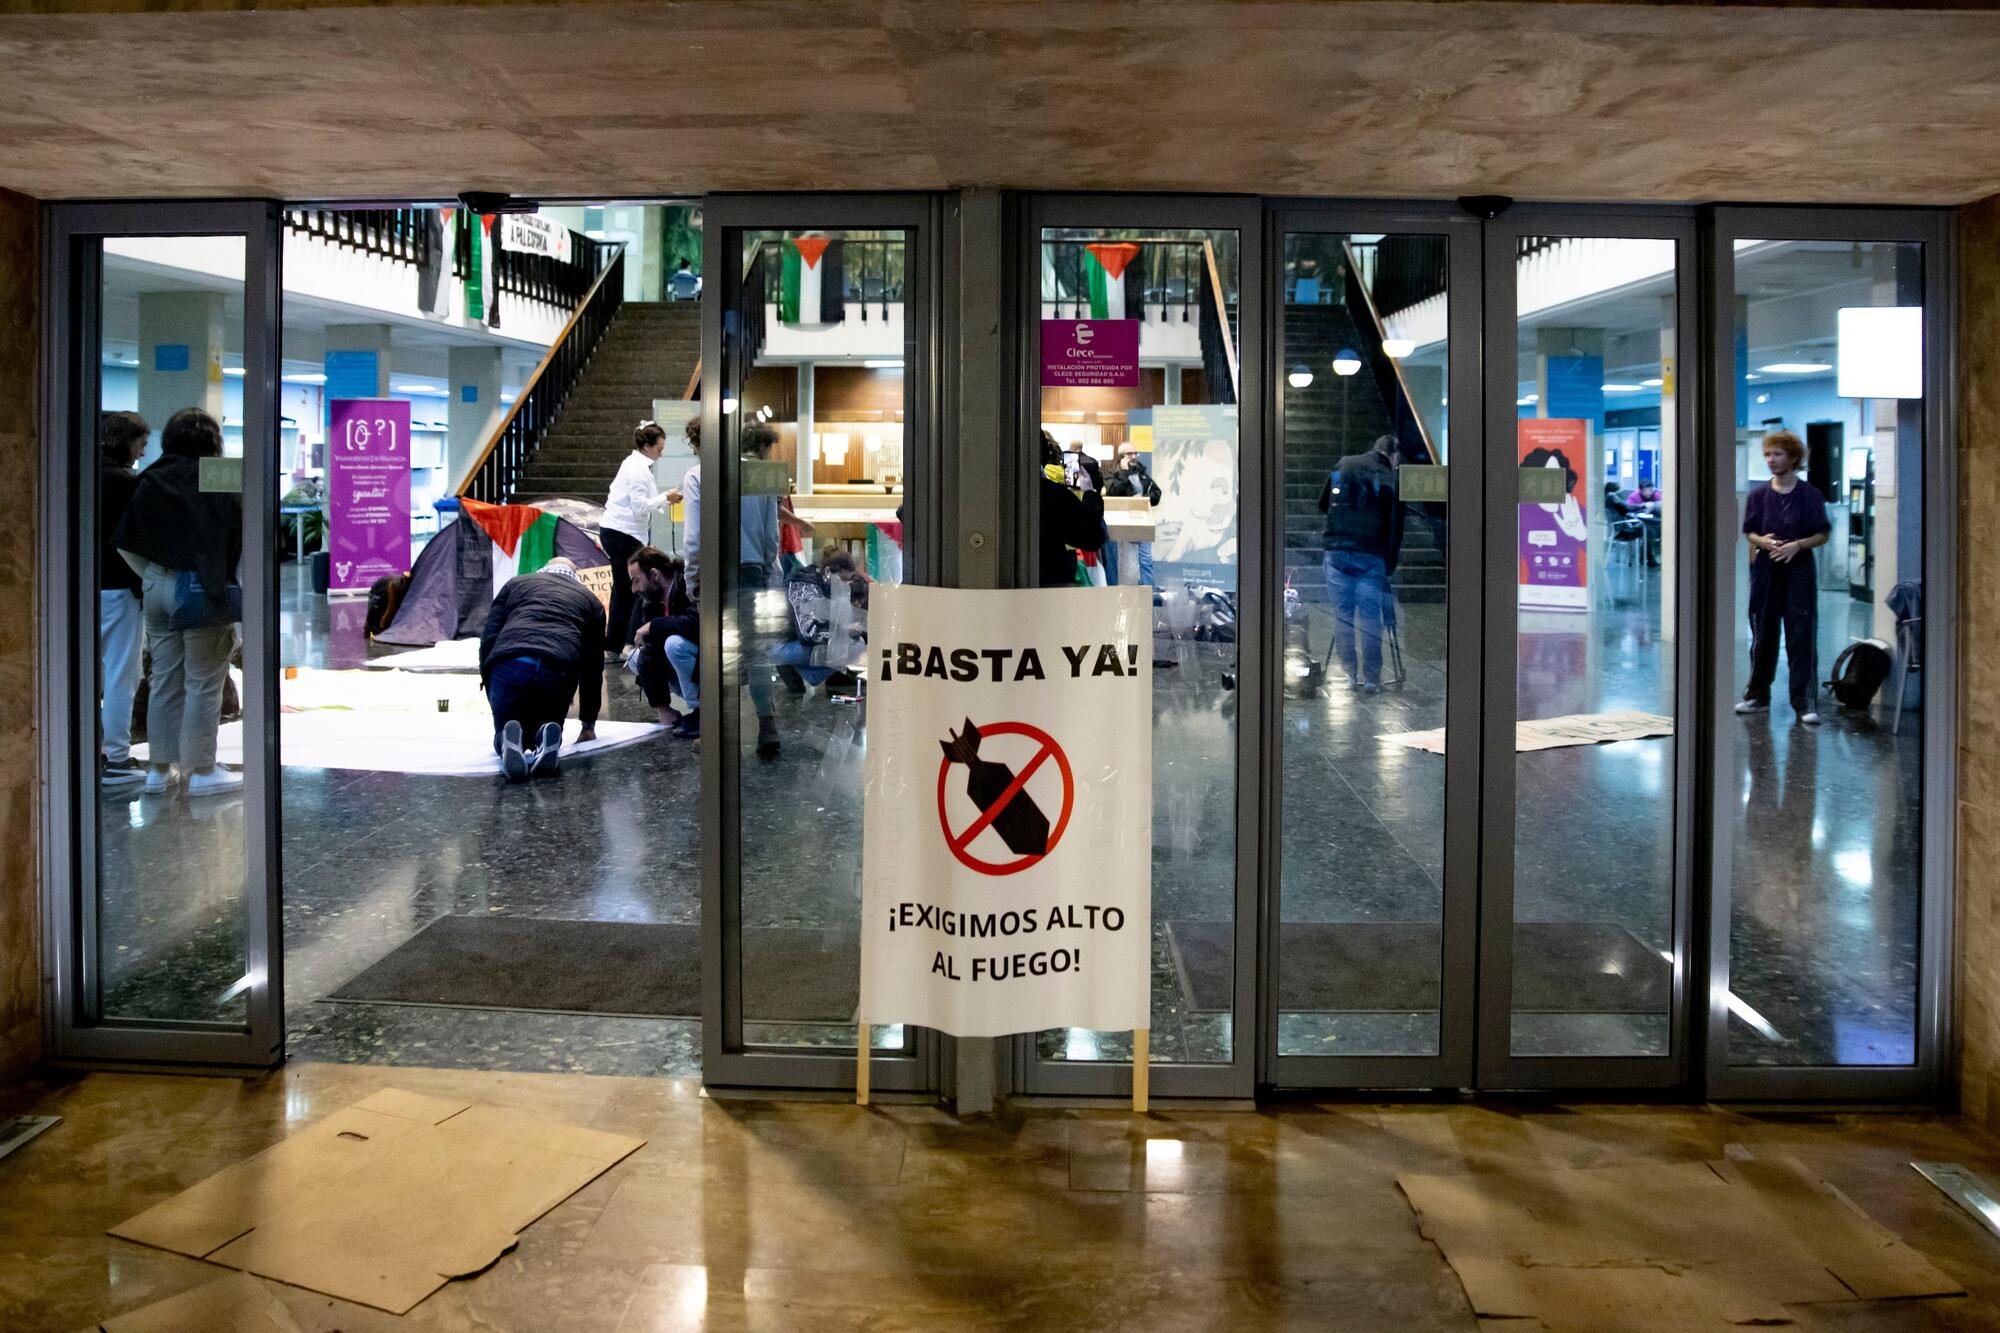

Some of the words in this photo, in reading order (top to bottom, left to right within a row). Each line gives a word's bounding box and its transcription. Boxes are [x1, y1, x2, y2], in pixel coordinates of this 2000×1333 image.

[1066, 347, 1095, 358] Clece
[881, 642, 1045, 683] ¡BASTA
[1062, 644, 1139, 678] YA!
[889, 902, 1038, 938] ¡EXIGIMOS
[1046, 905, 1125, 931] ALTO
[931, 951, 961, 981] AL
[972, 948, 1081, 982] FUEGO!
